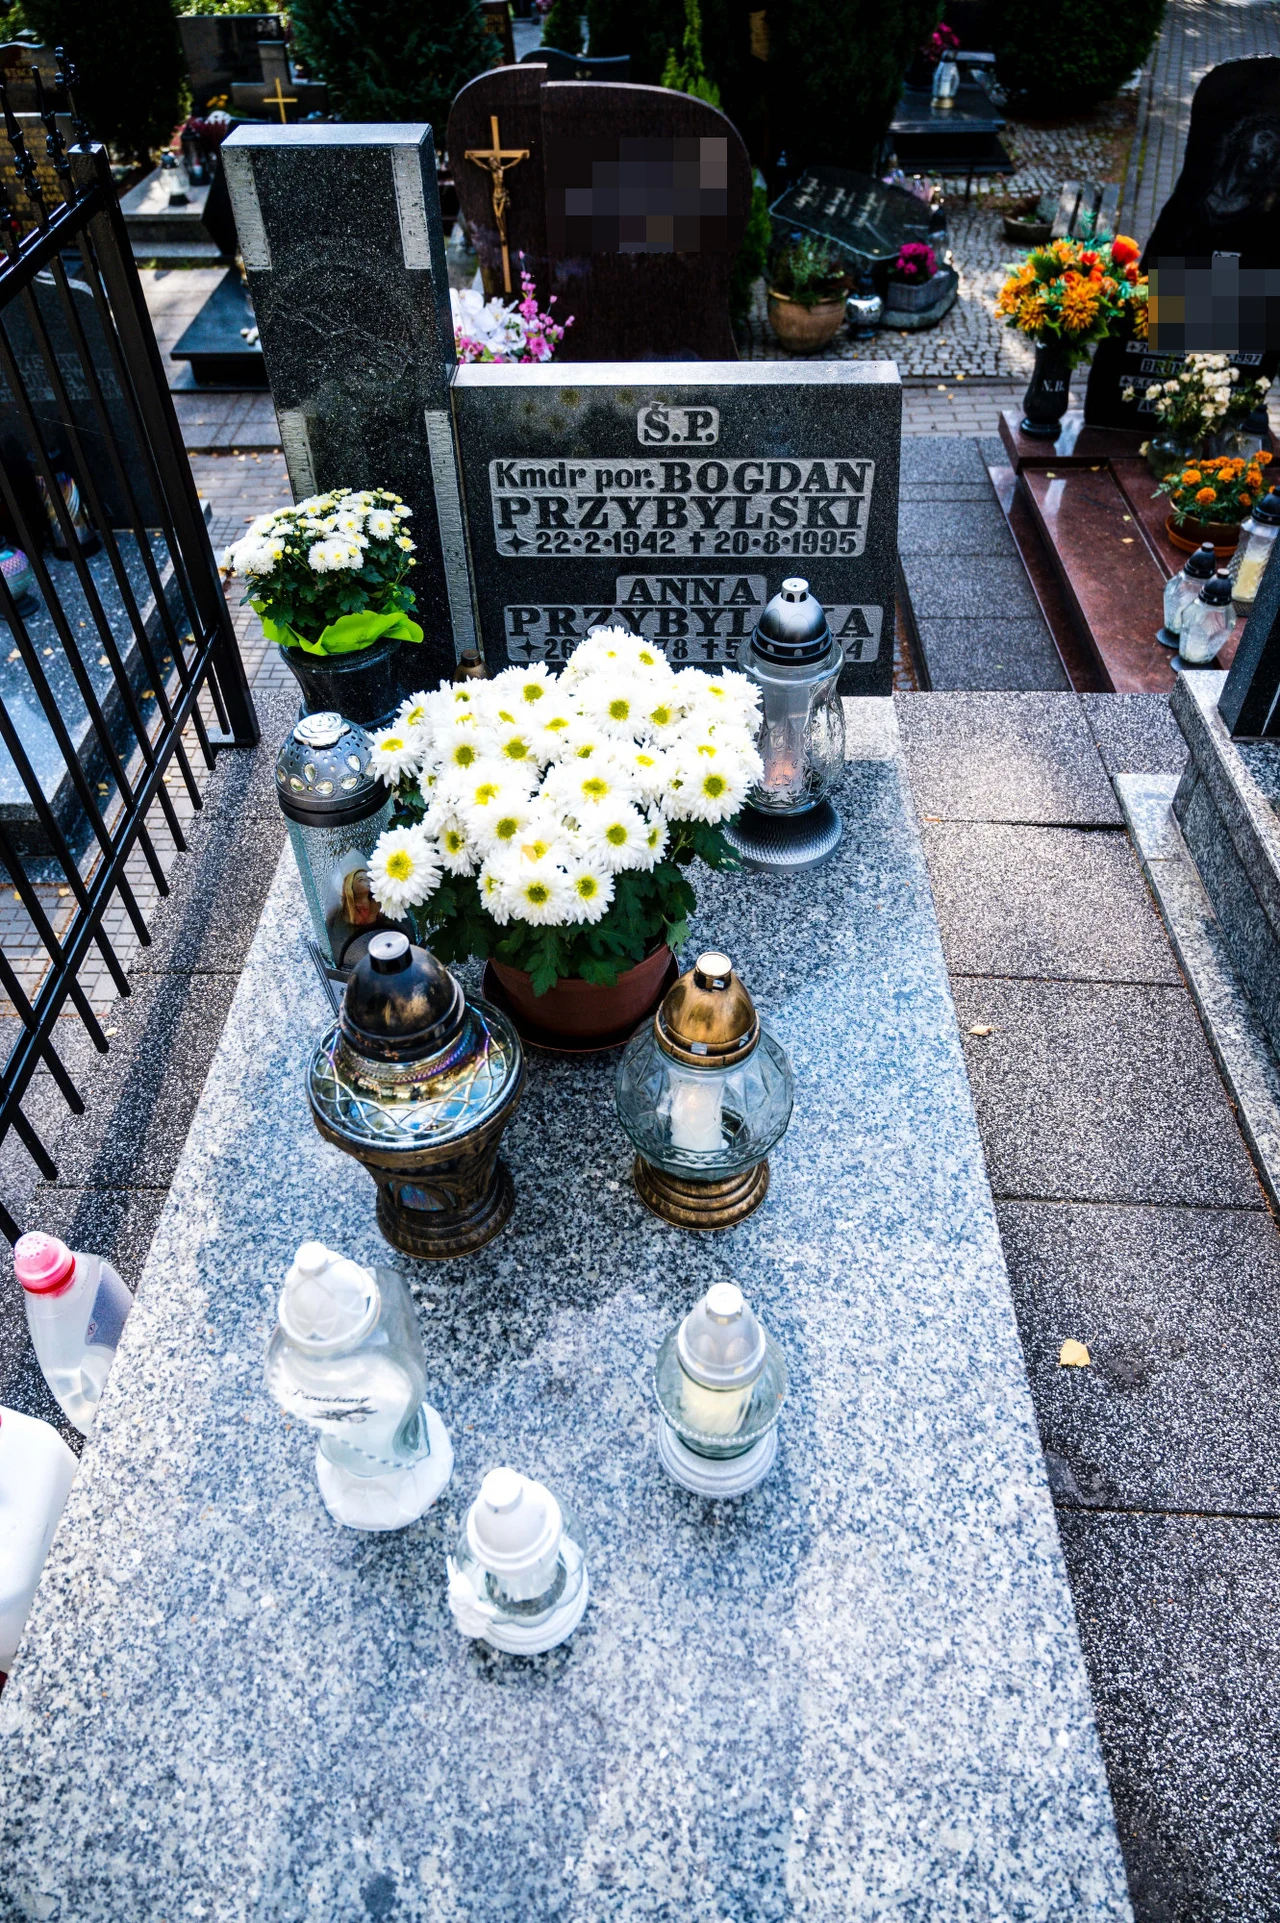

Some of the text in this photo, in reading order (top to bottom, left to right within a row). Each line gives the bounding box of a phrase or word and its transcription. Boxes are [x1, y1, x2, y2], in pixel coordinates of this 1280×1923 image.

[643, 401, 715, 443] Ś.P.
[496, 460, 872, 495] Kmdr por. BOGDAN
[497, 495, 866, 530] PRZYBYLSKI
[621, 577, 761, 605] ANNA
[506, 607, 874, 638] PRZYBYLA
